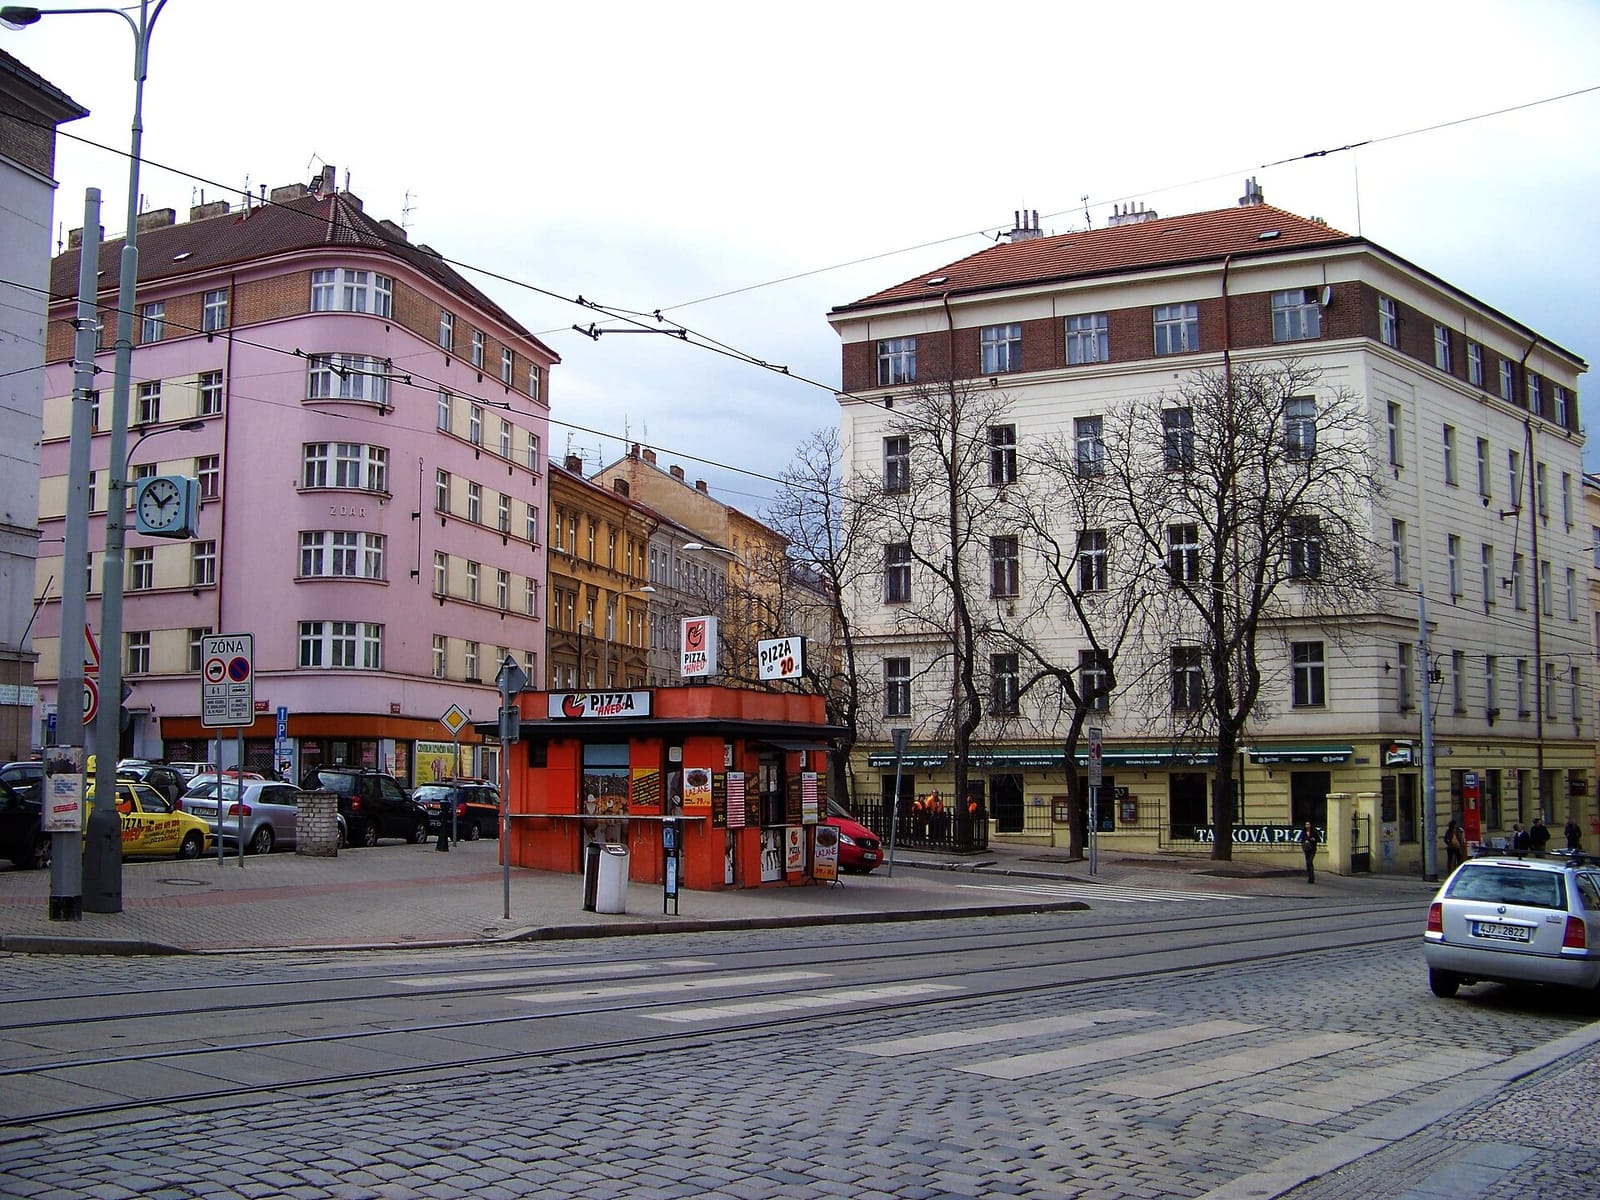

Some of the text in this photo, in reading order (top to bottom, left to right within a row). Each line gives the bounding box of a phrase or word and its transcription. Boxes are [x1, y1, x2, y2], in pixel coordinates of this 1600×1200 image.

[329, 505, 367, 518] ZDAR
[210, 639, 244, 654] ZÓNA
[760, 639, 792, 666] PIZZA
[684, 652, 706, 664] PIZZA
[780, 656, 795, 676] 20
[590, 693, 634, 712] PIZZA
[1196, 827, 1269, 842] TAKOVÁ
[1480, 924, 1525, 938] 4J7 2822
